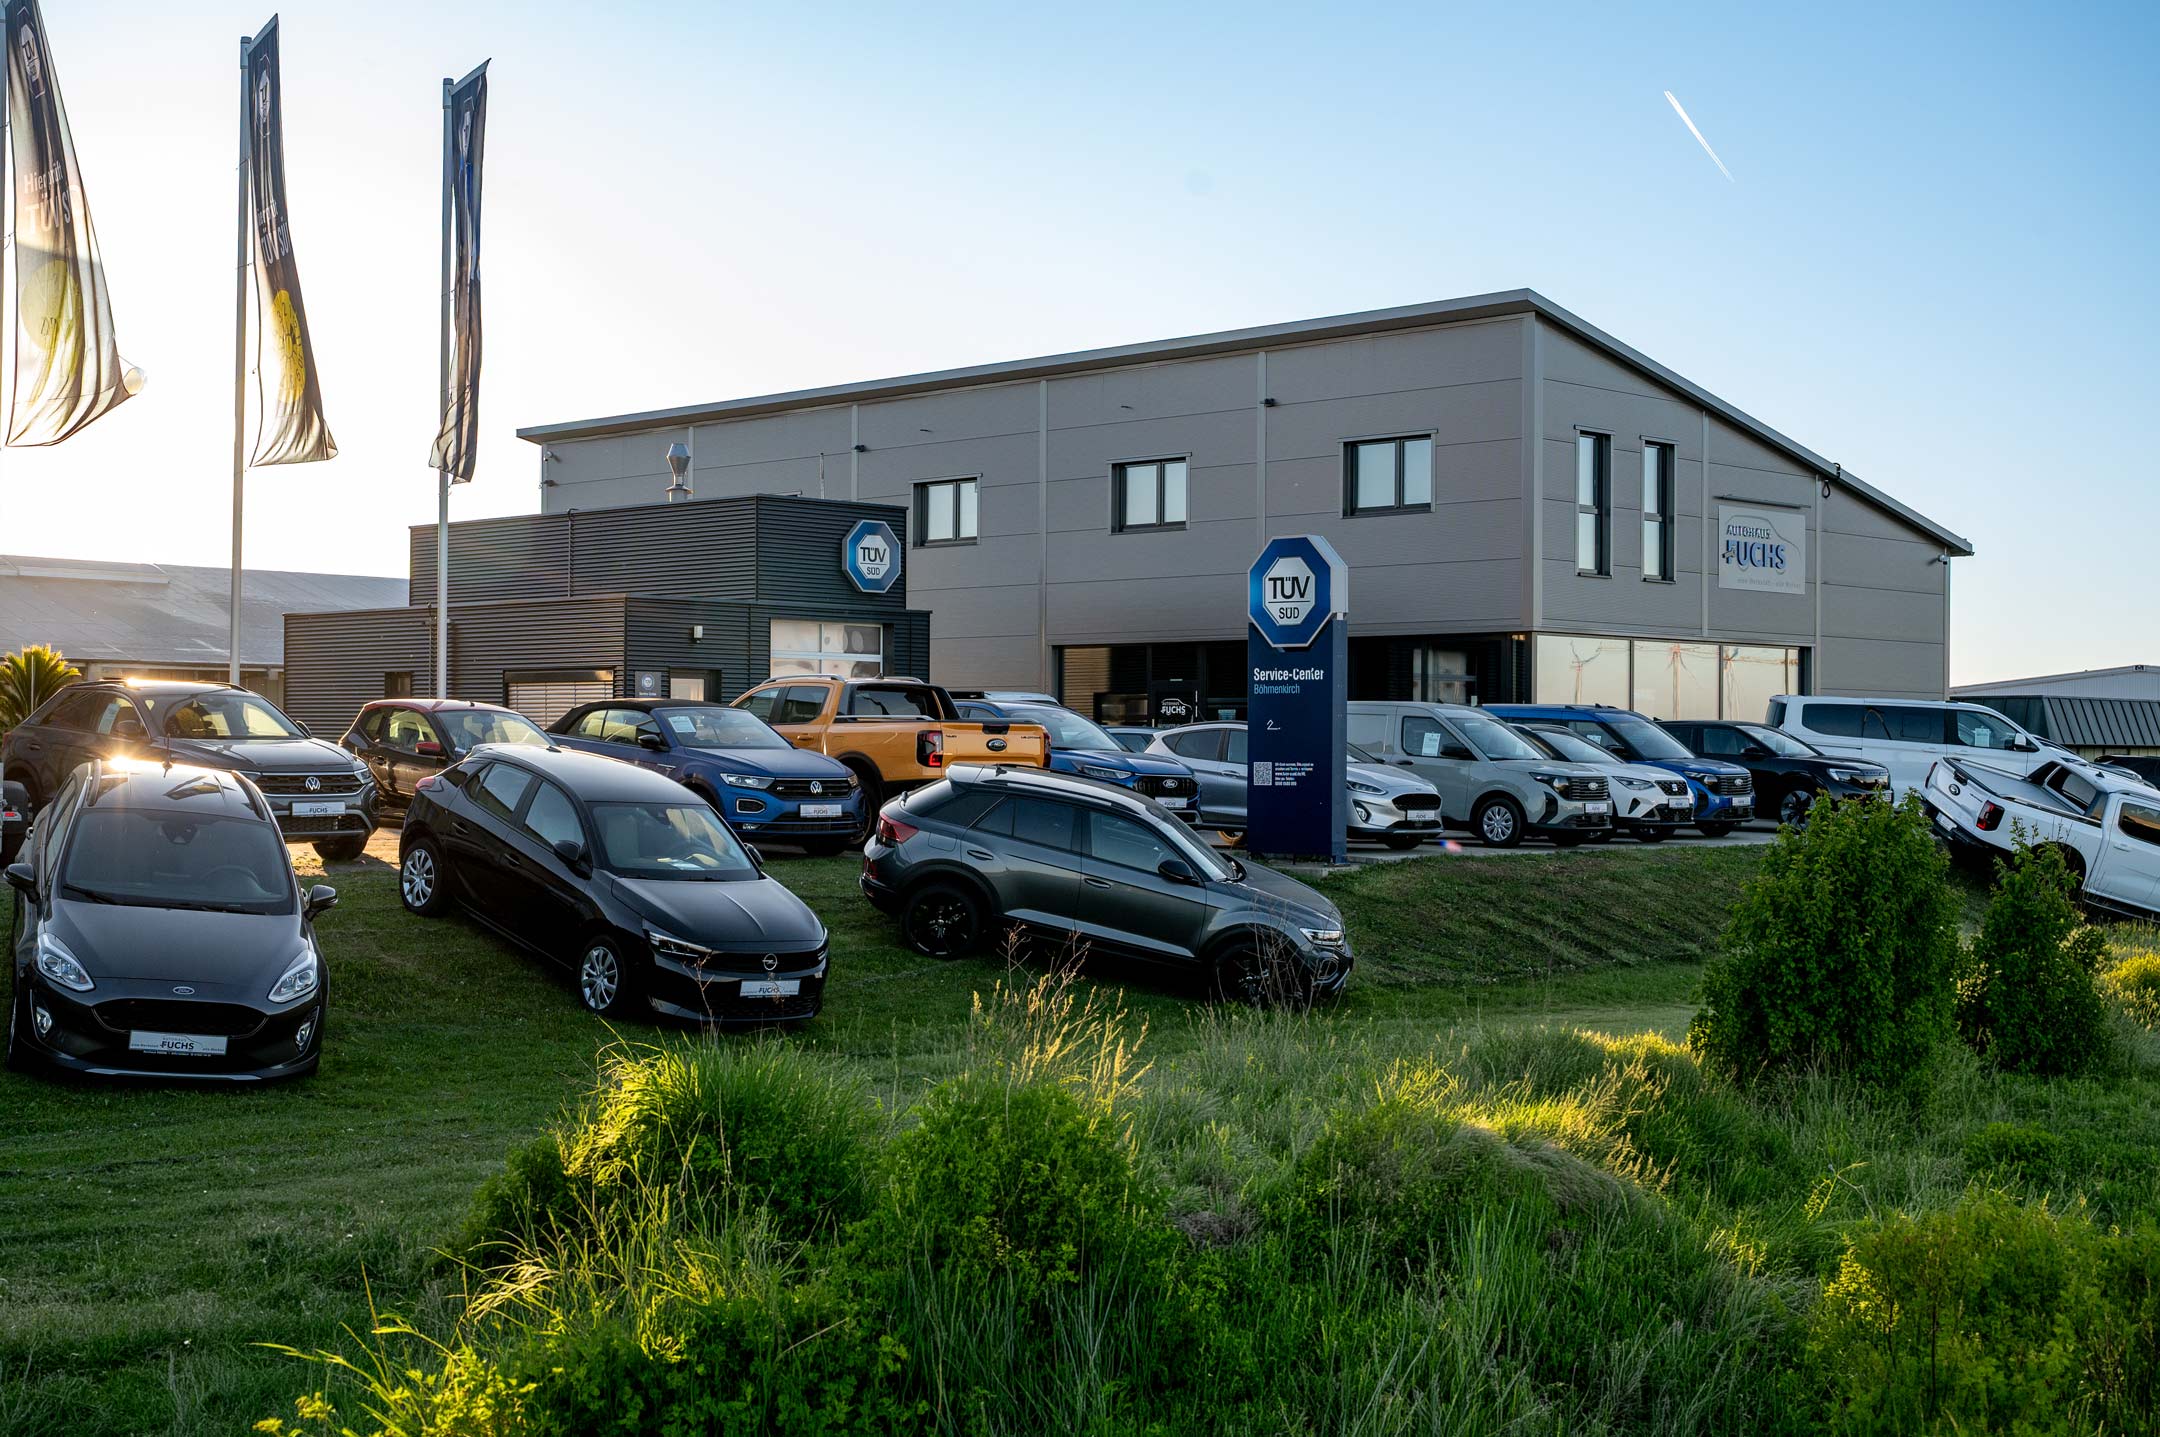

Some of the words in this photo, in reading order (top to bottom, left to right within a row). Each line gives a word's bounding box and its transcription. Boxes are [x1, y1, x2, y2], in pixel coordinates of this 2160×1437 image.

[24, 171, 48, 194] Hier
[1727, 524, 1771, 540] AUTOHAUS
[860, 546, 887, 563] TÜV
[1723, 539, 1787, 570] FUCHS
[866, 566, 881, 576] SÜD
[1268, 575, 1311, 600] TÜV
[1278, 606, 1300, 620] SÜD
[1253, 667, 1324, 681] Service-Center
[1253, 683, 1300, 695] Böhmenkirch
[1161, 706, 1186, 714] FUCHS
[160, 1040, 194, 1050] FUCHS
